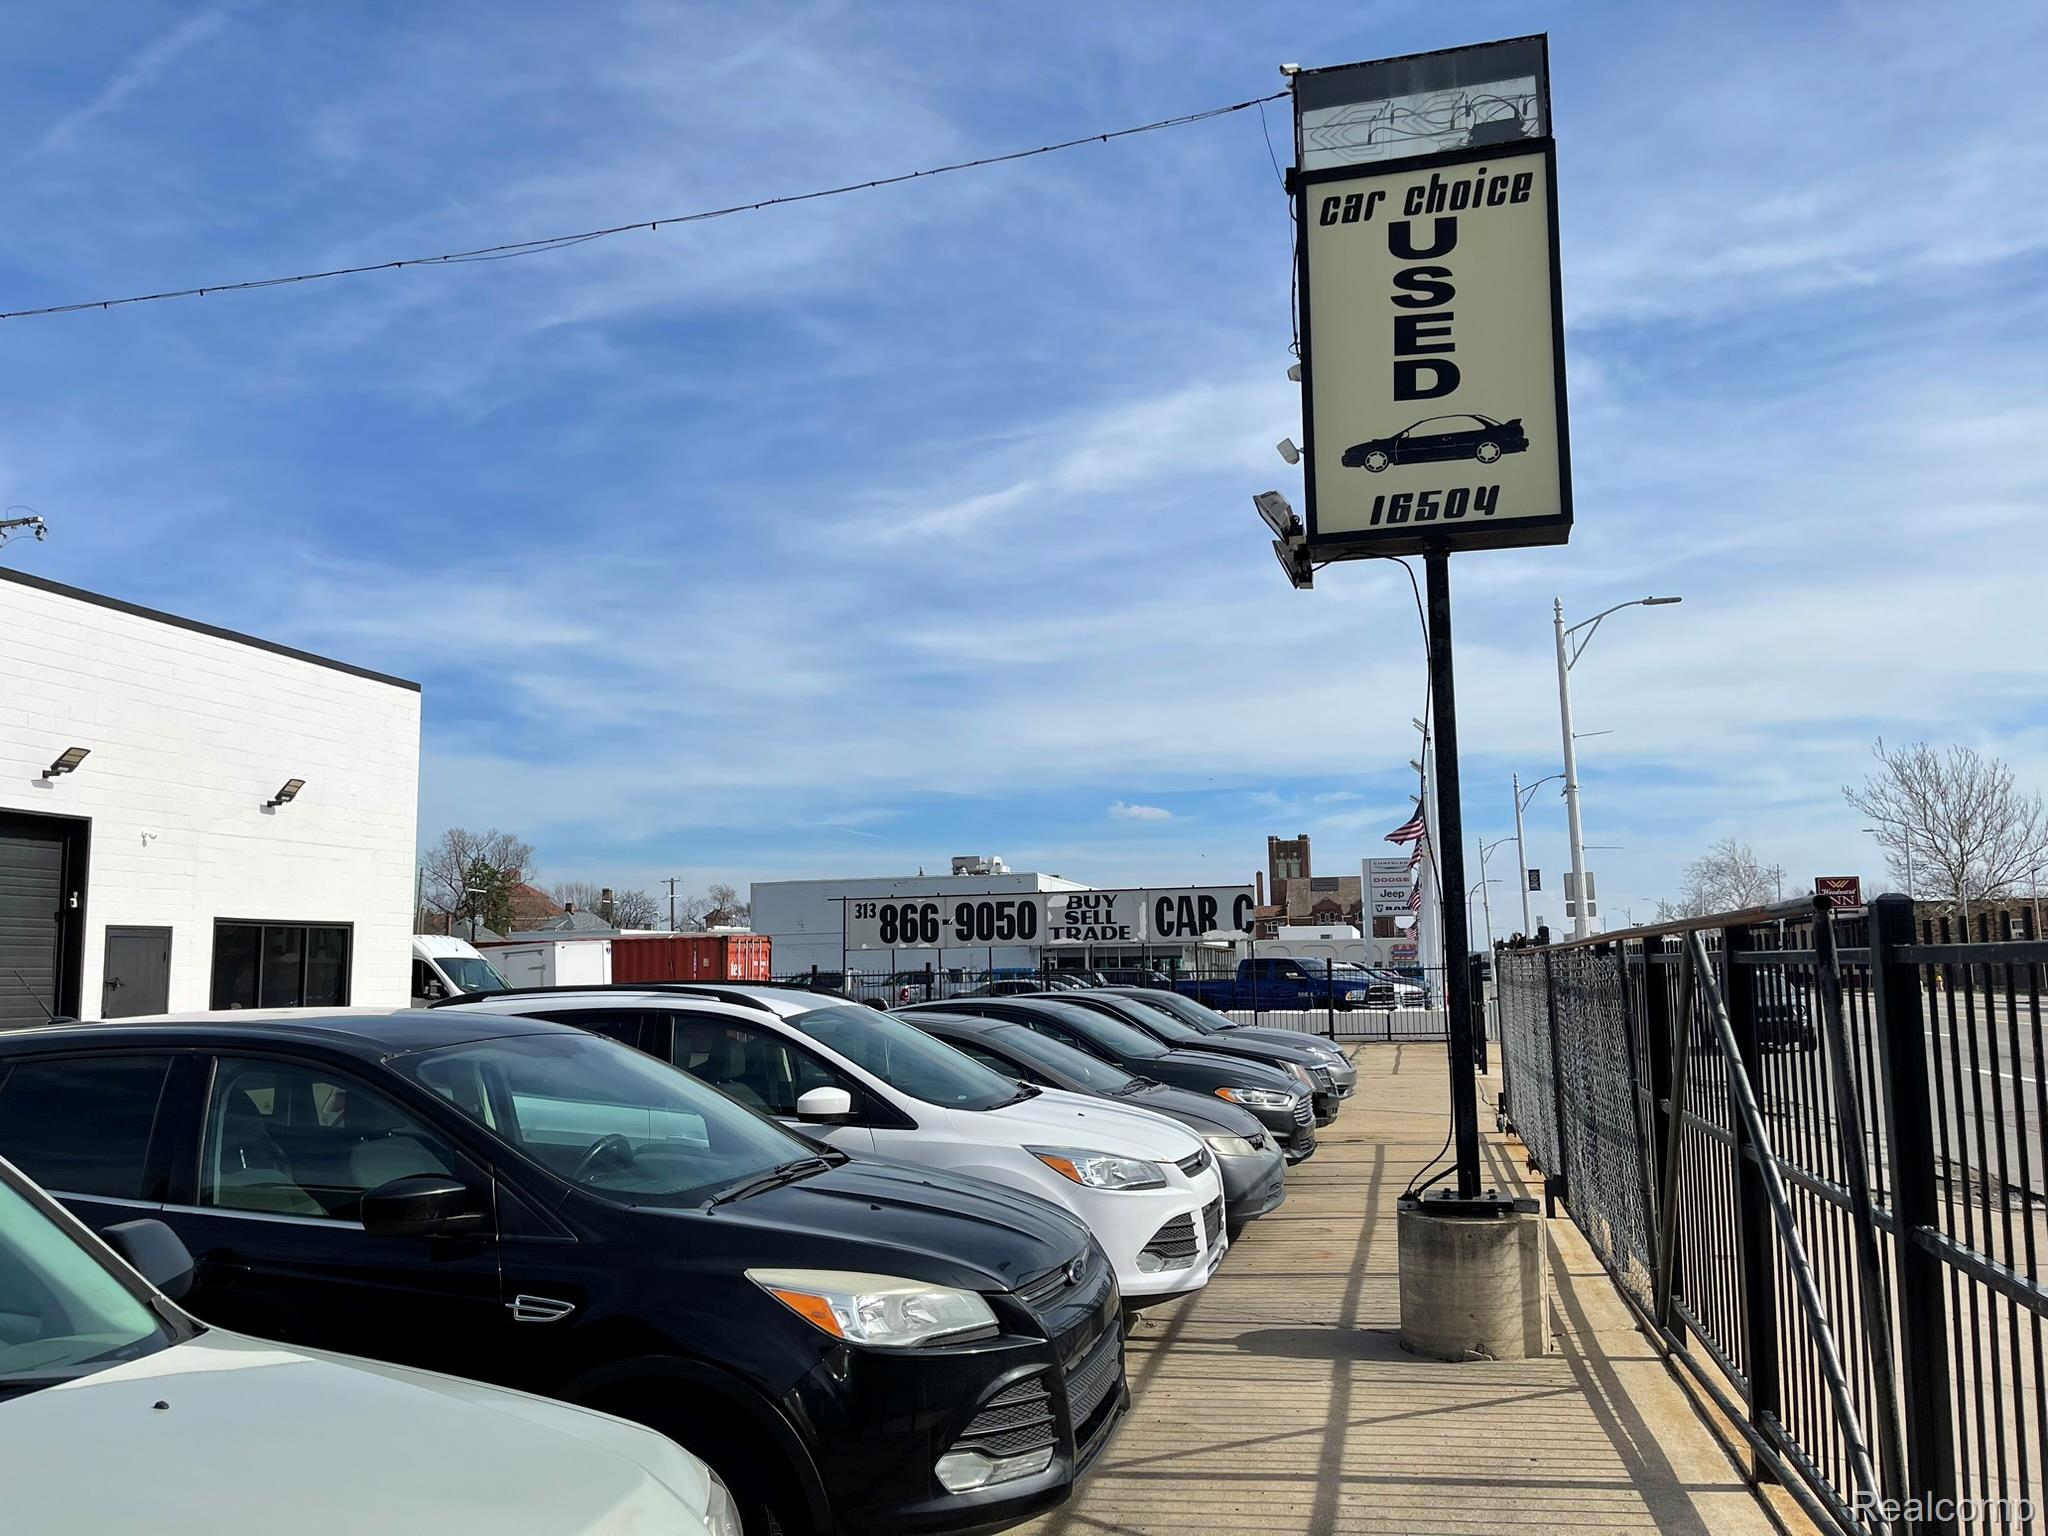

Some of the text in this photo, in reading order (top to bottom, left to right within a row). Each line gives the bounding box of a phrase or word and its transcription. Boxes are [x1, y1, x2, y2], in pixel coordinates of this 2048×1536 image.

[1319, 167, 1534, 226] car choice
[1387, 216, 1461, 401] USED
[1370, 485, 1500, 526] 16504
[1066, 894, 1118, 910] BUY
[1380, 889, 1405, 898] Jeep
[1829, 895, 1855, 905] NN
[854, 900, 1038, 944] 313 866-9050
[1064, 910, 1118, 925] SELL
[1155, 894, 1218, 937] CAR
[1049, 925, 1131, 941] TRADE
